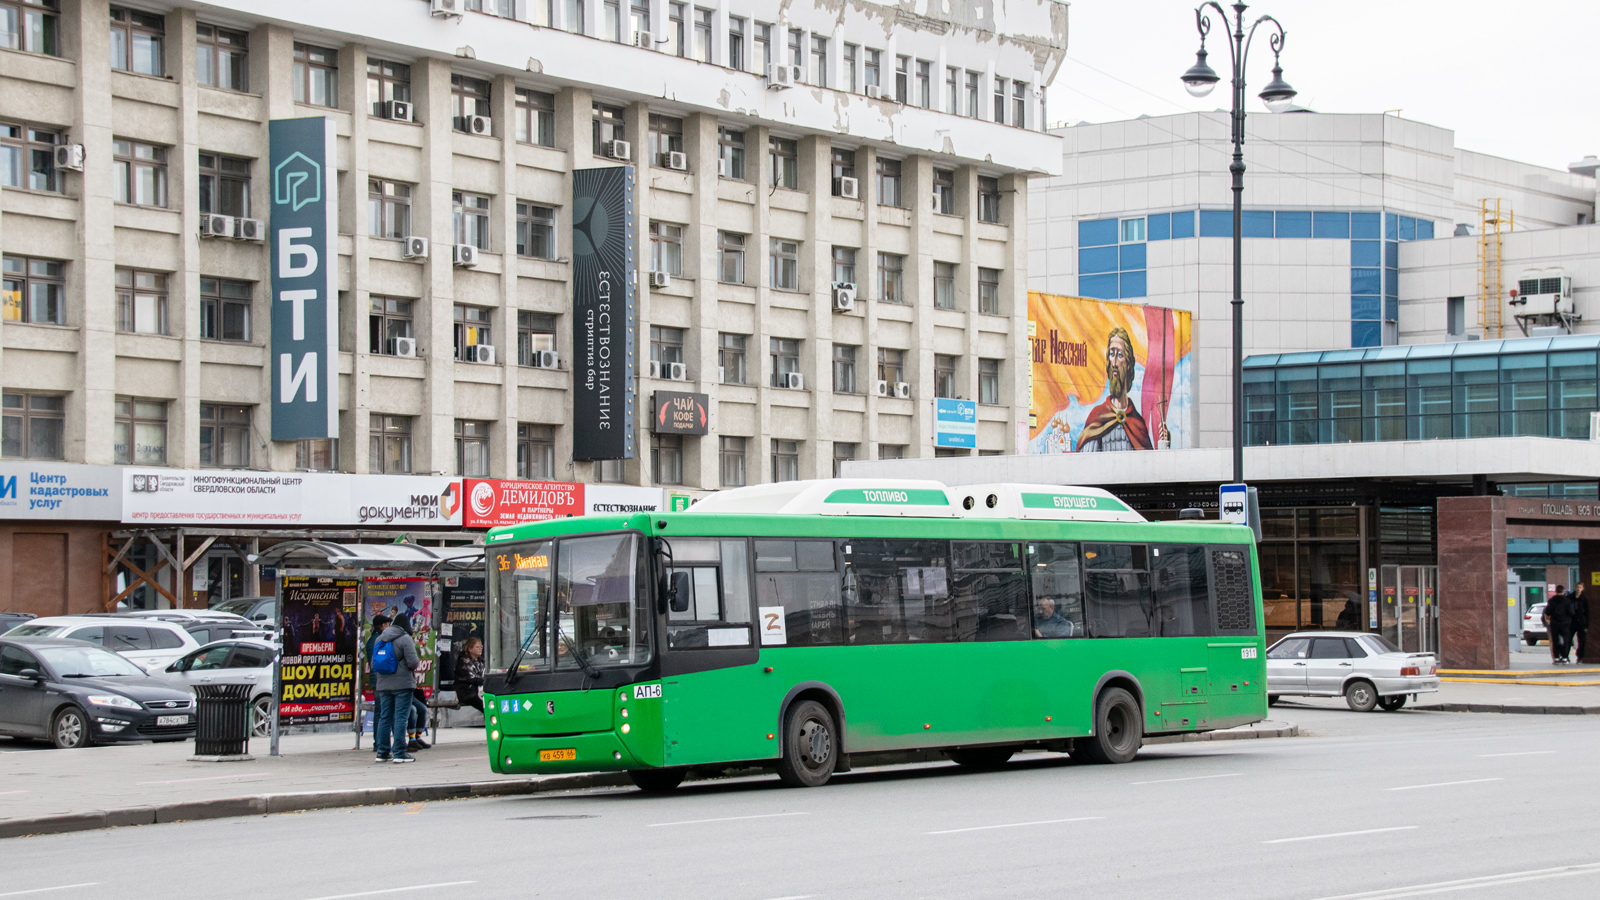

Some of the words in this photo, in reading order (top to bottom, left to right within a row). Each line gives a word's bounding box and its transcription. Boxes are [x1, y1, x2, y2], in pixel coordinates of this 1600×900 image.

[278, 227, 319, 403] БТИ
[585, 309, 595, 371] стриптиз
[585, 370, 598, 390] бар
[673, 396, 694, 411] ЧАЙ
[673, 411, 694, 422] КОФЕ
[30, 472, 67, 485] Центр
[193, 475, 281, 485] МНОГОФУНКЦИОНАЛЬНЫЙ
[281, 477, 303, 486] ЦЕНТР
[30, 486, 109, 498] кадастровых
[246, 486, 276, 494] ОБЛАСТИ
[500, 481, 543, 490] ЮРИДИЧЕСКОЕ
[543, 483, 575, 491] АГЕНТСТВО
[500, 489, 575, 507] ДЕМИДОВЪ
[863, 490, 908, 502] ТОПЛИВО
[1053, 496, 1097, 508] БУДУЩЕГО
[29, 499, 63, 510] услуг
[1542, 503, 1573, 515] ПЛОЩАДЬ
[1577, 505, 1590, 515] 1905
[196, 512, 241, 520] государственных
[247, 512, 288, 520] муниципальных
[289, 513, 302, 521] услуг
[359, 505, 439, 523] документы
[289, 588, 339, 605] Искушение
[302, 642, 334, 652] ПРЕМЬЕРА!
[302, 654, 346, 664] ПРОГРАММЫ!
[1242, 649, 1256, 658] 1911
[282, 665, 317, 680] ШОУ
[320, 664, 353, 680] ПОД
[282, 682, 351, 701] ДОЖДЕМ
[636, 685, 661, 698] АП-6
[552, 750, 564, 759] 459
